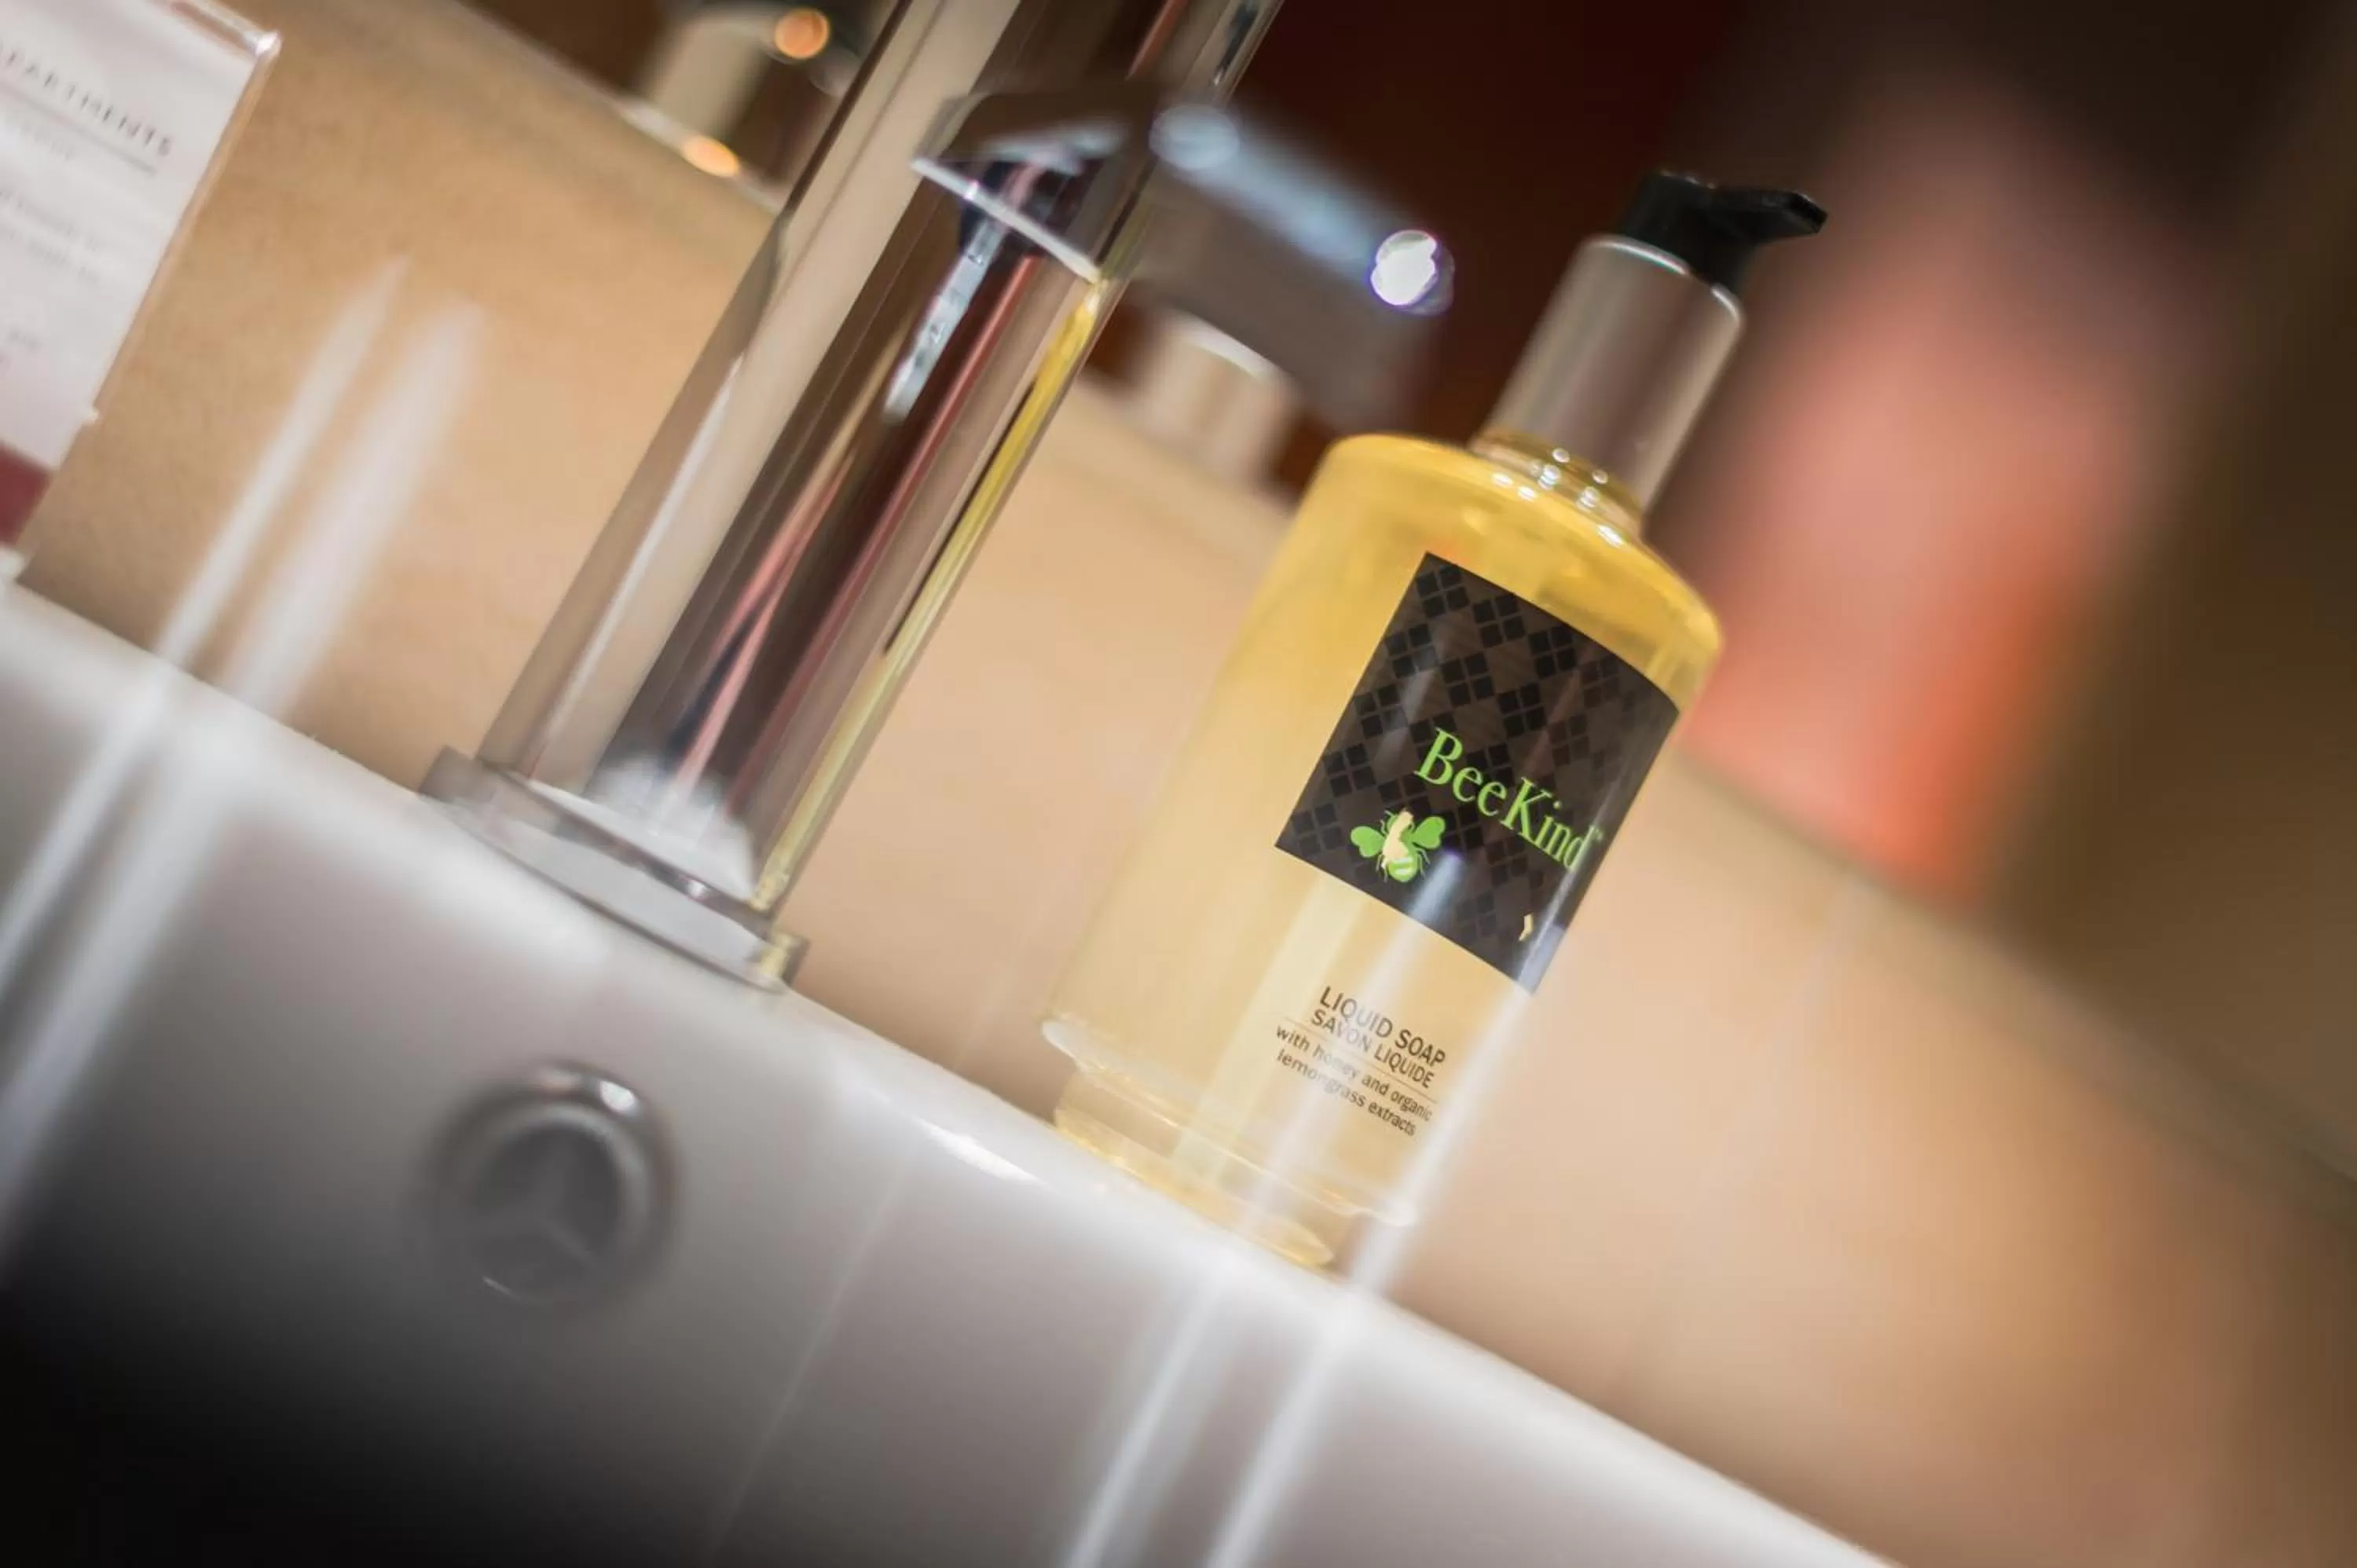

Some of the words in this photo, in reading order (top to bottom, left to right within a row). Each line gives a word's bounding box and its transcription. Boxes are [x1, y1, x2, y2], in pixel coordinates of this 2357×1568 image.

[0, 39, 172, 157] PARTMENTS
[1311, 1008, 1373, 1053] SAVON
[1374, 1042, 1435, 1090] LIQUIDE
[1319, 985, 1394, 1039] LIQUID
[1395, 1028, 1446, 1068] SOAP
[1276, 1024, 1311, 1053] with
[1312, 1043, 1362, 1081] honey
[1361, 1072, 1390, 1097] and
[1390, 1090, 1433, 1123] organic
[1276, 1048, 1366, 1108] lemongrass
[1367, 1100, 1417, 1137] extracts
